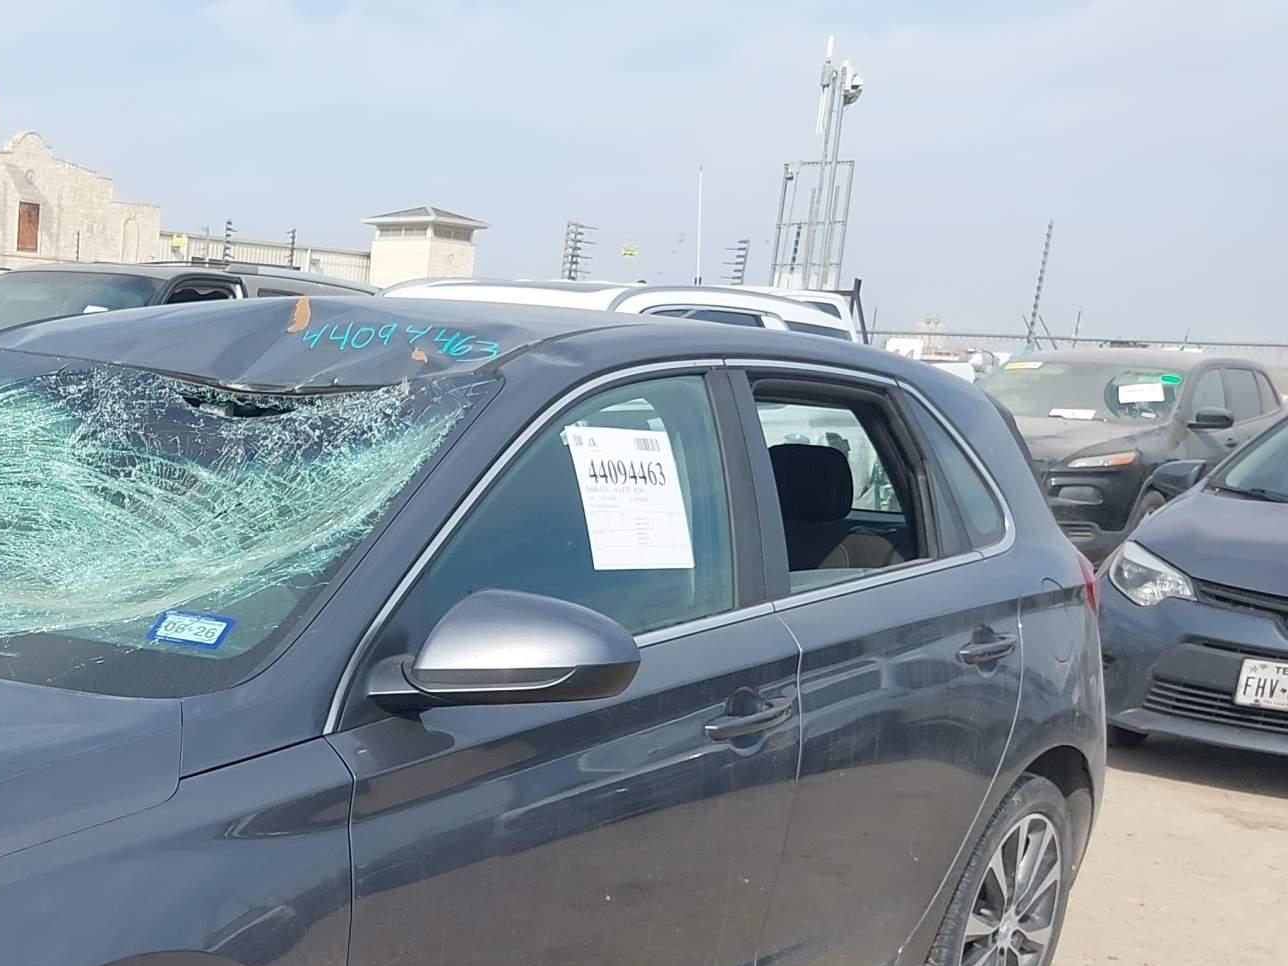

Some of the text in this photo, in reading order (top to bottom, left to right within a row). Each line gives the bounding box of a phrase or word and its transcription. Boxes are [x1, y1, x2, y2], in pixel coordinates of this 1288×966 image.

[302, 321, 500, 362] 44094463
[588, 459, 666, 486] 44094463
[1242, 676, 1280, 698] FHV
